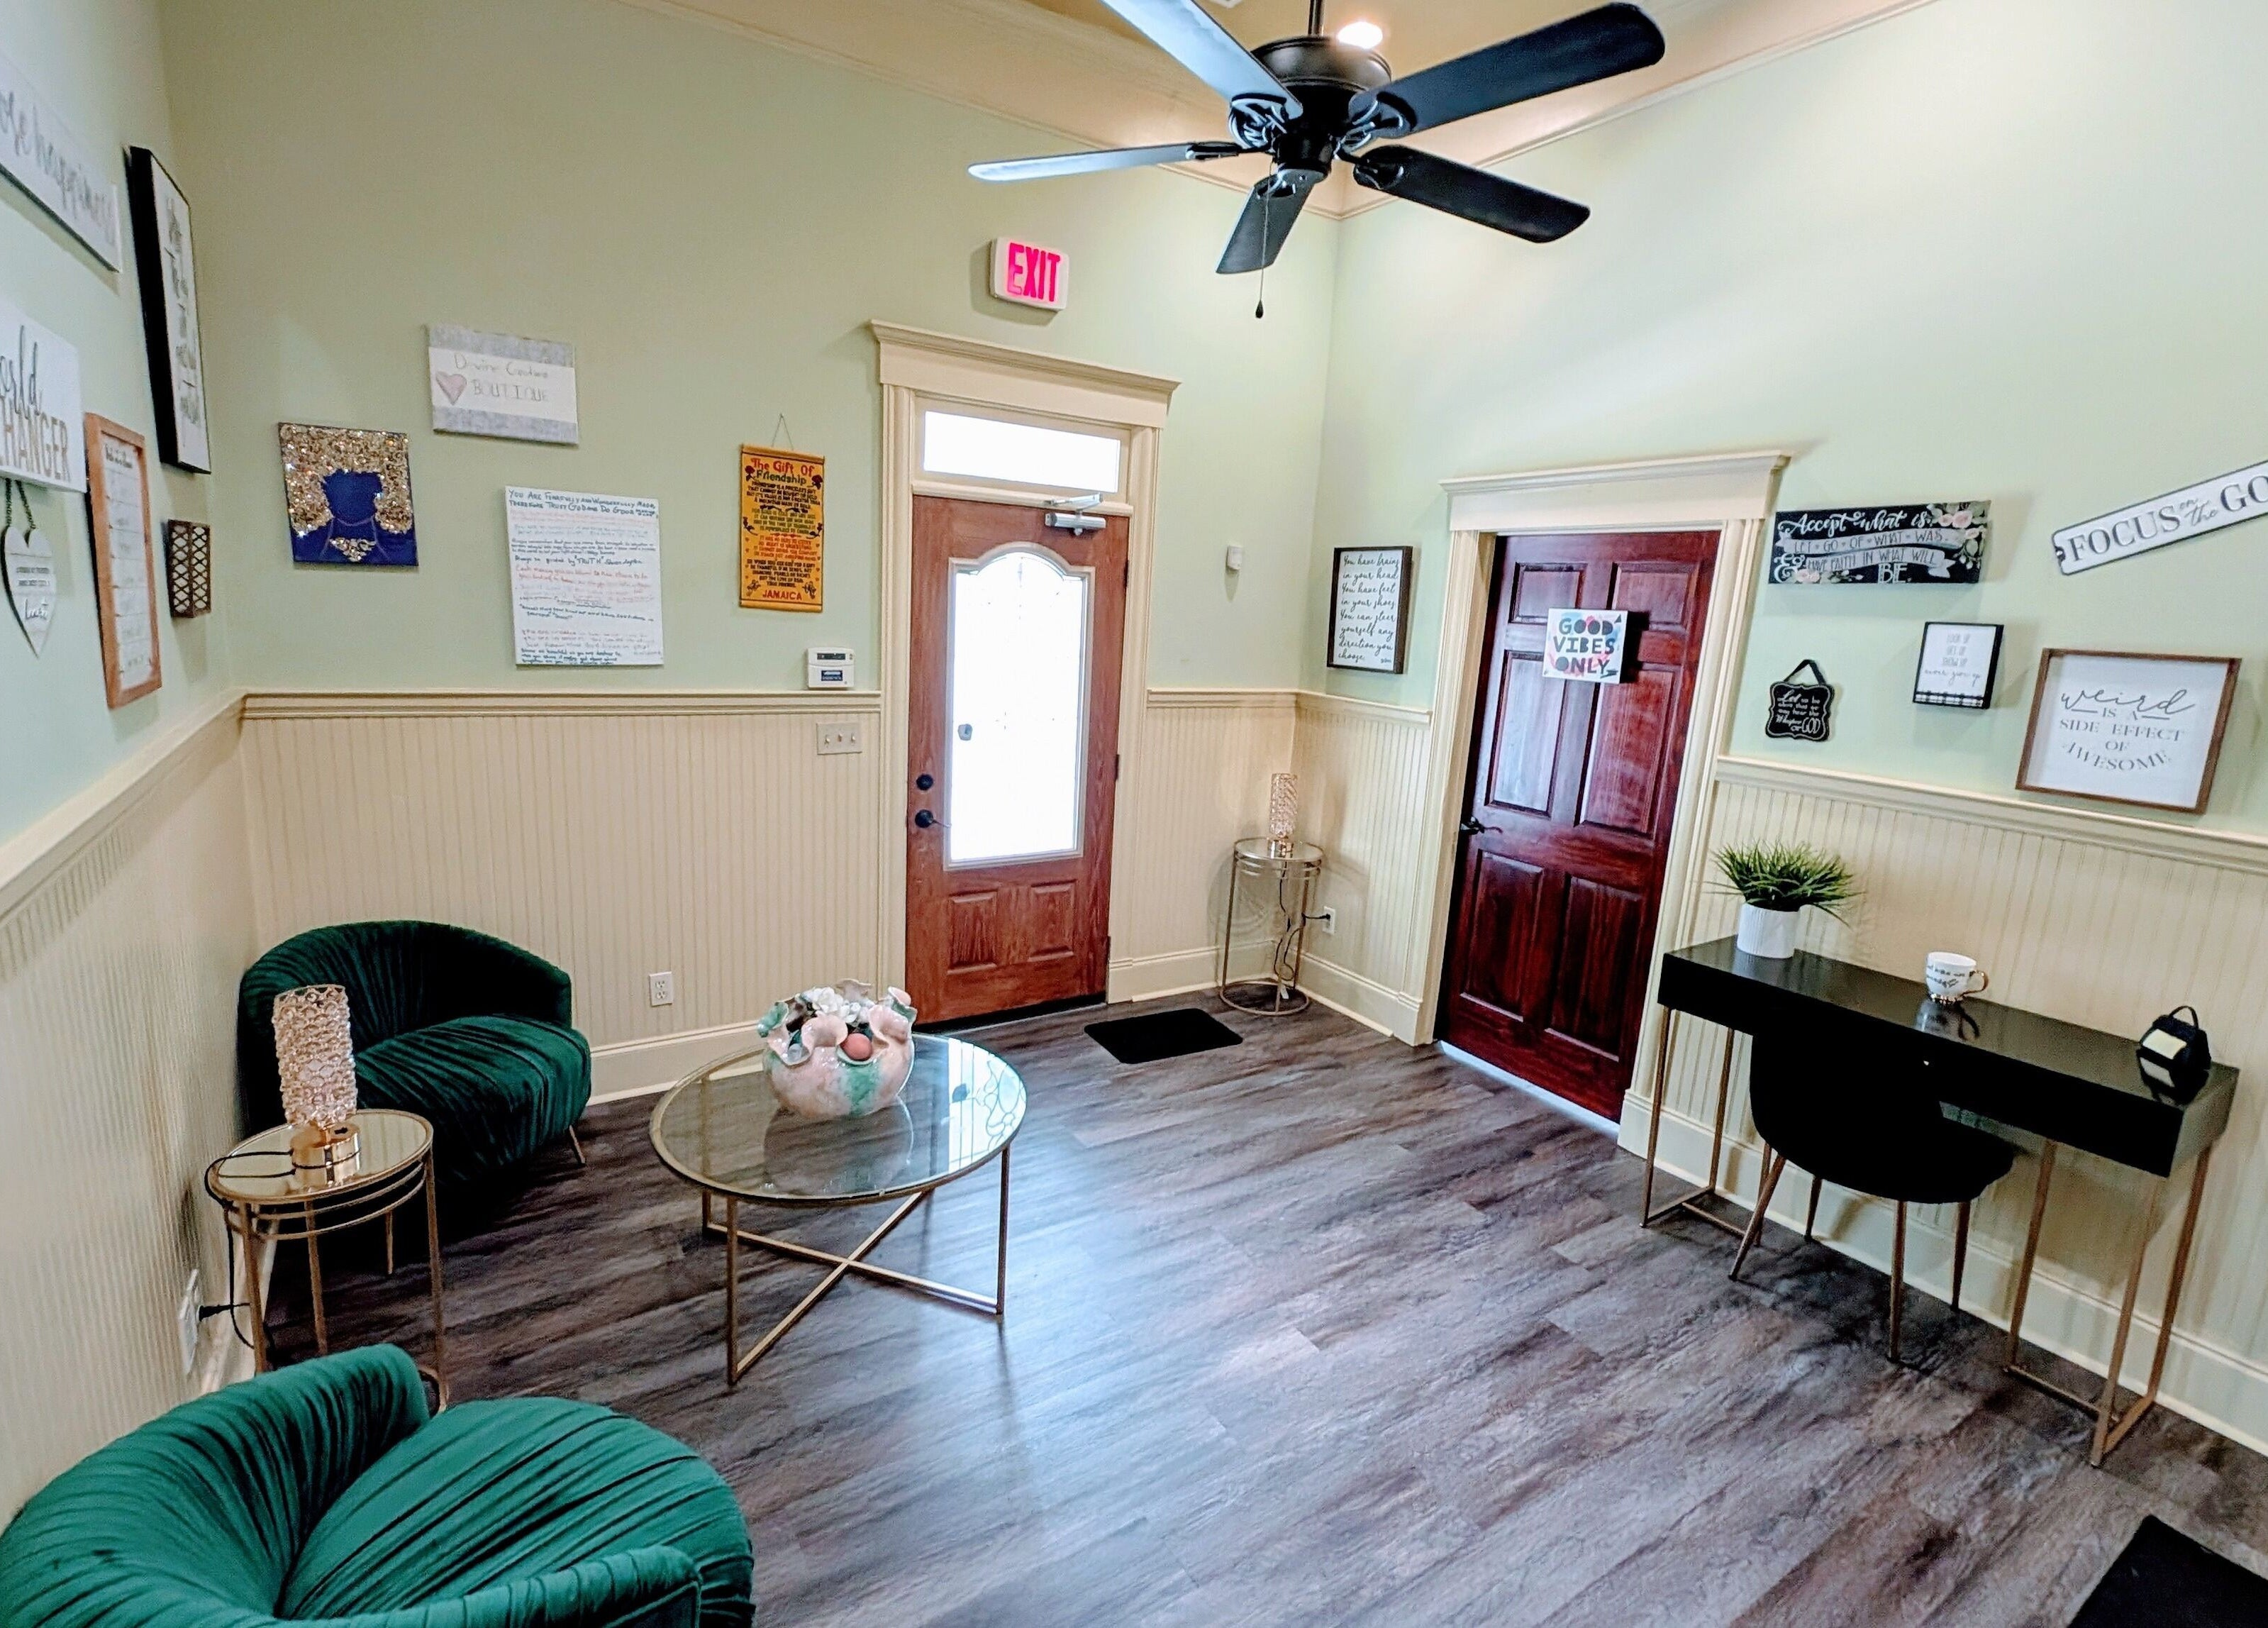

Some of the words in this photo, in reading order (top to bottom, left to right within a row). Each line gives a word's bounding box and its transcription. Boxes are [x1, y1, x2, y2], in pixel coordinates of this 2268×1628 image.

[1007, 243, 1061, 301] EXIT
[0, 325, 44, 419] orld
[0, 396, 71, 483] HANGER
[751, 458, 769, 470] The
[773, 460, 794, 474] Gift
[801, 465, 815, 477] Of
[757, 470, 806, 485] Friendship
[528, 491, 541, 500] ARE
[2220, 475, 2268, 513] GO
[2179, 499, 2199, 509] on
[2184, 499, 2218, 526] the
[1777, 512, 1852, 538] Accept
[1853, 510, 1907, 531] what
[2068, 505, 2181, 562] FOCUS
[1795, 541, 1811, 553] LET
[1823, 540, 1838, 552] GO
[1850, 536, 1864, 548] OF
[1874, 531, 1903, 546] WHAT
[1344, 555, 1355, 567] You
[1357, 554, 1375, 565] have
[1377, 553, 1399, 567] brains
[1830, 553, 1856, 571] FAITH
[1862, 552, 1873, 566] IN
[1879, 548, 1904, 563] WHAT
[1912, 548, 1937, 567] WILL
[1352, 572, 1374, 587] your
[1377, 567, 1399, 579] head
[762, 589, 802, 600] JAMAICA
[1343, 582, 1355, 594] You
[1357, 582, 1377, 593] have
[1379, 582, 1396, 595] feet
[1350, 599, 1372, 613] your
[1373, 595, 1394, 609] shoes
[1340, 609, 1354, 620] You
[1374, 611, 1396, 624] steer
[1339, 622, 1373, 638] yourself
[1378, 629, 1394, 642] any
[1559, 618, 1613, 636] GOOD
[1339, 636, 1375, 648] direction
[1374, 644, 1394, 656] you
[1553, 636, 1616, 655] VIBES
[1555, 656, 1610, 675] ONLY
[2061, 689, 2196, 714] weird
[2102, 707, 2117, 717] IS
[2128, 710, 2138, 721] A
[1802, 716, 1821, 734] GOD
[2060, 719, 2100, 733] SIDE
[2111, 724, 2184, 741] EFFECT
[2106, 741, 2129, 751] OF
[2062, 742, 2172, 771] AWESOME
